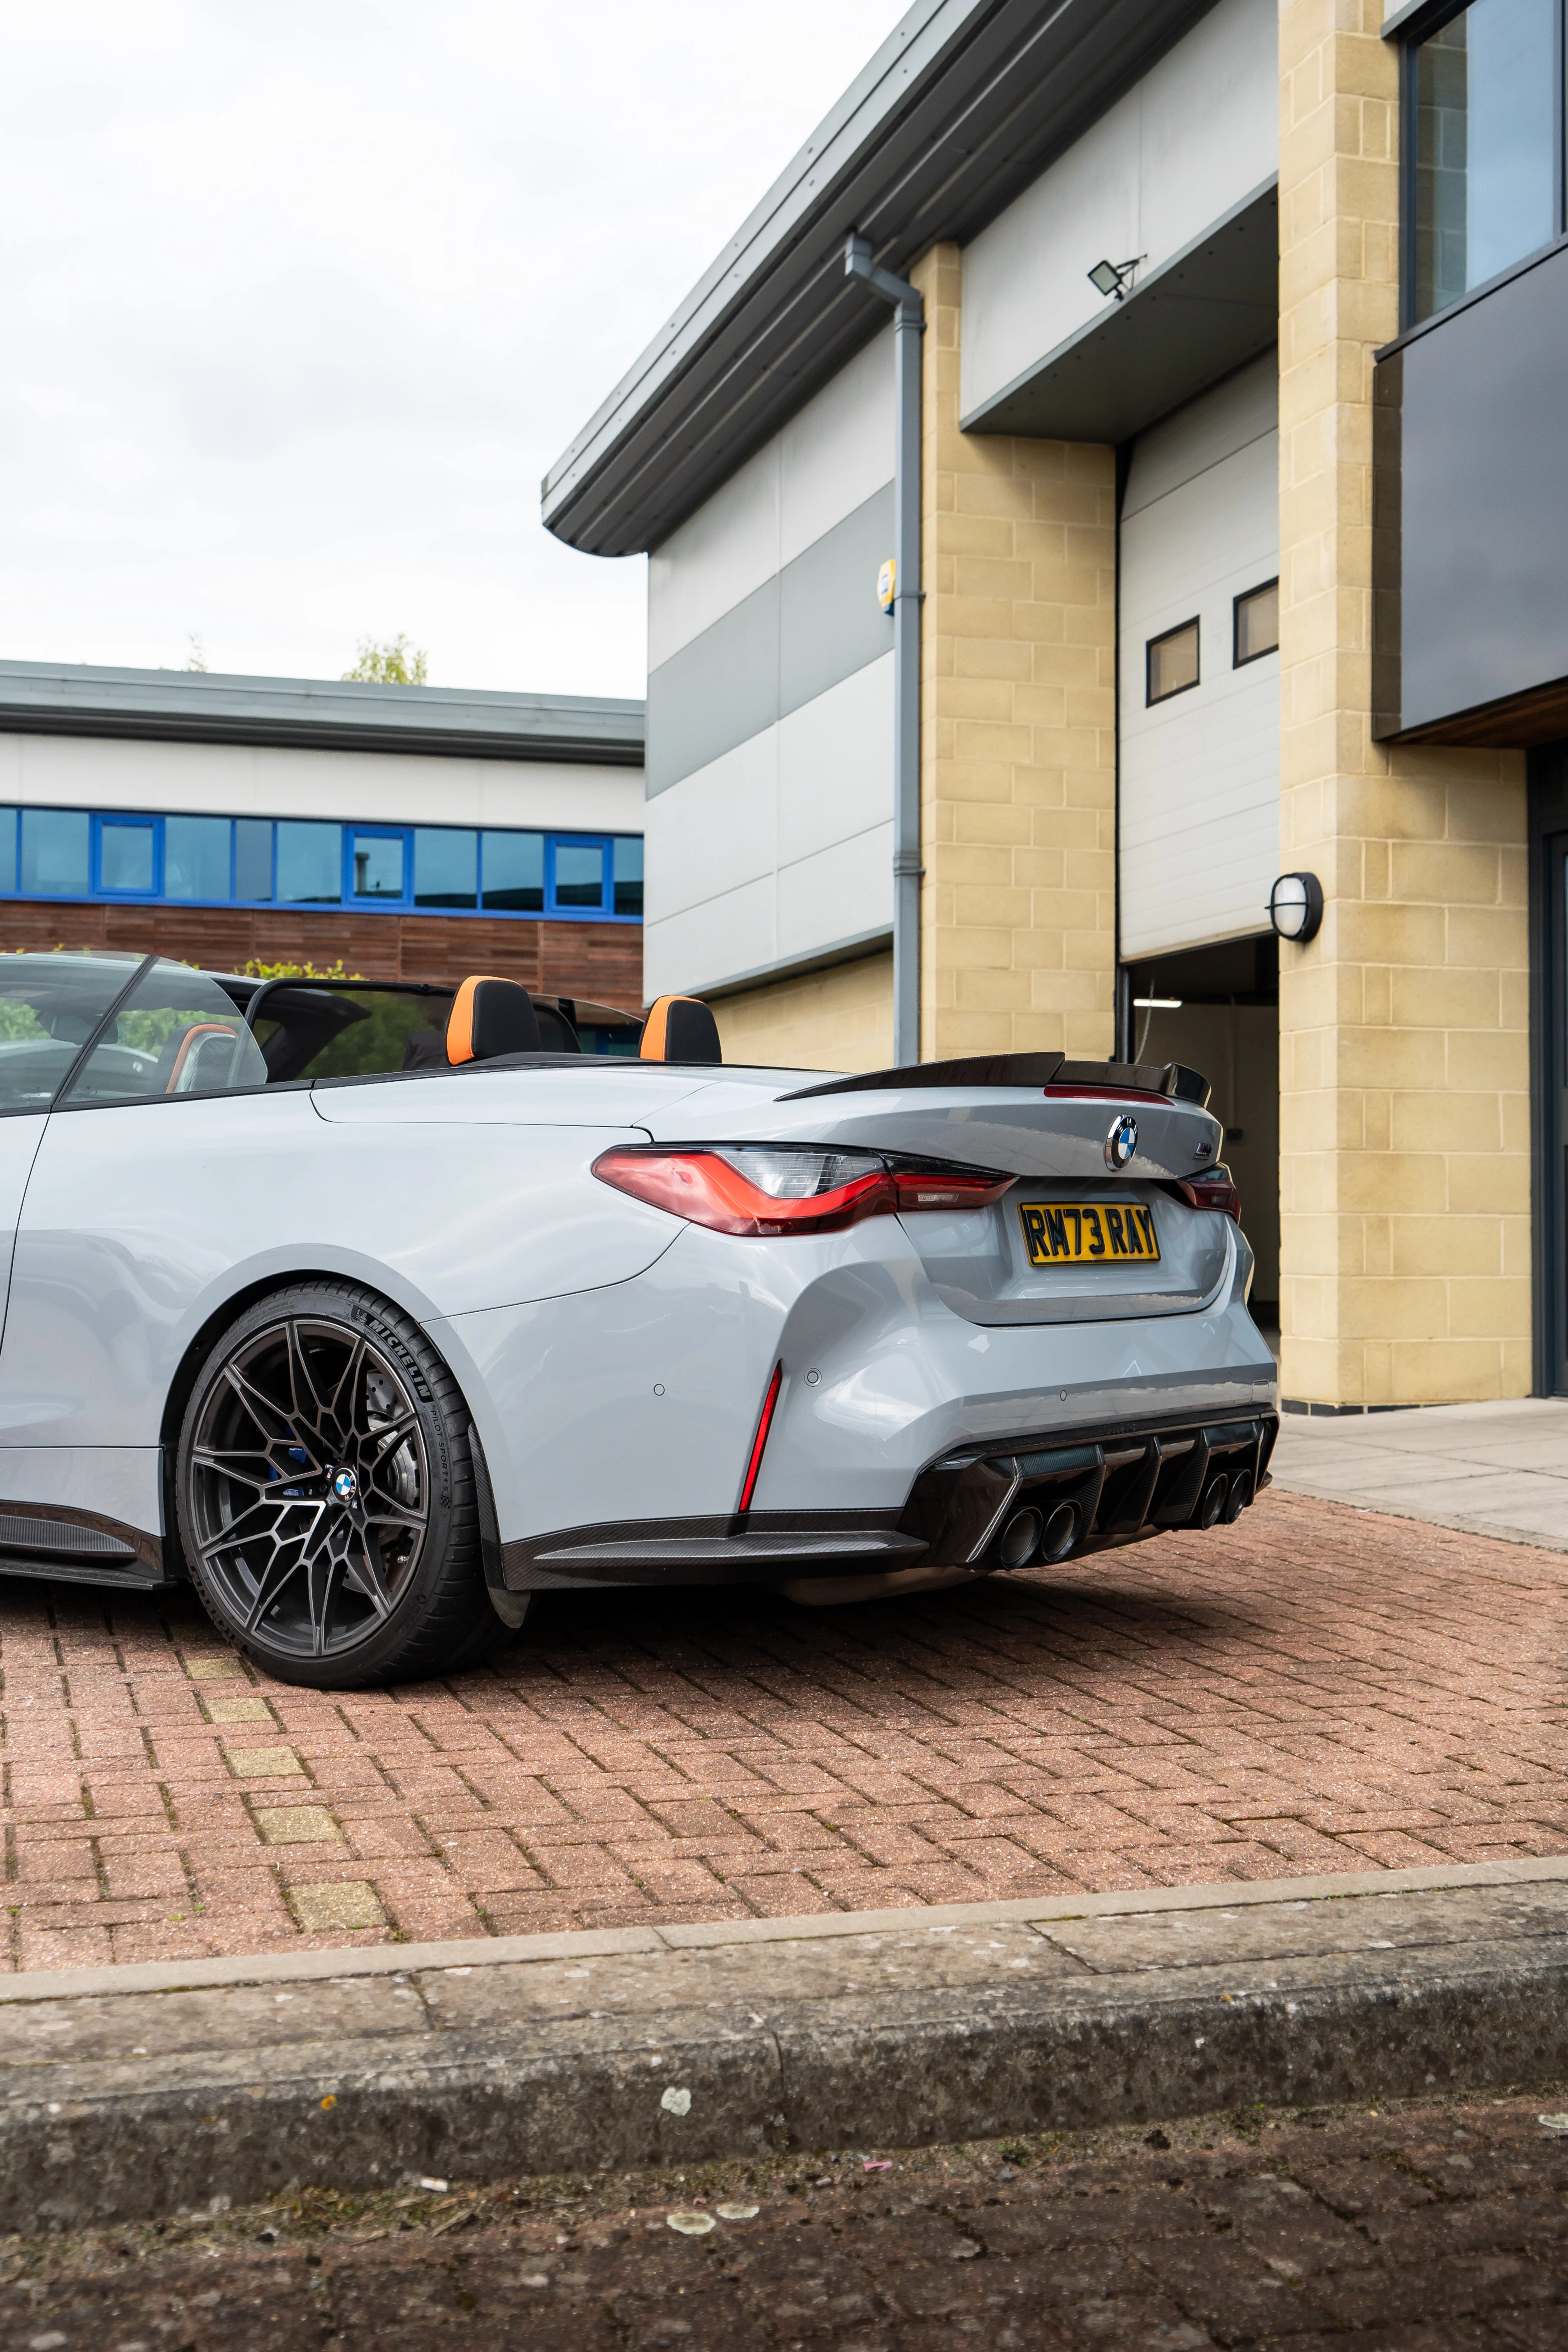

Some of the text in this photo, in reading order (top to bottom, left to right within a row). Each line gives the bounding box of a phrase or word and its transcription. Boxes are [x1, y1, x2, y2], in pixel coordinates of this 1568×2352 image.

[1024, 1209, 1153, 1257] RM73 RAY
[368, 1320, 431, 1397] MICHELIN
[431, 1411, 442, 1437] PILOT
[439, 1442, 448, 1476] SPORT
[344, 1475, 355, 1501] BMW
